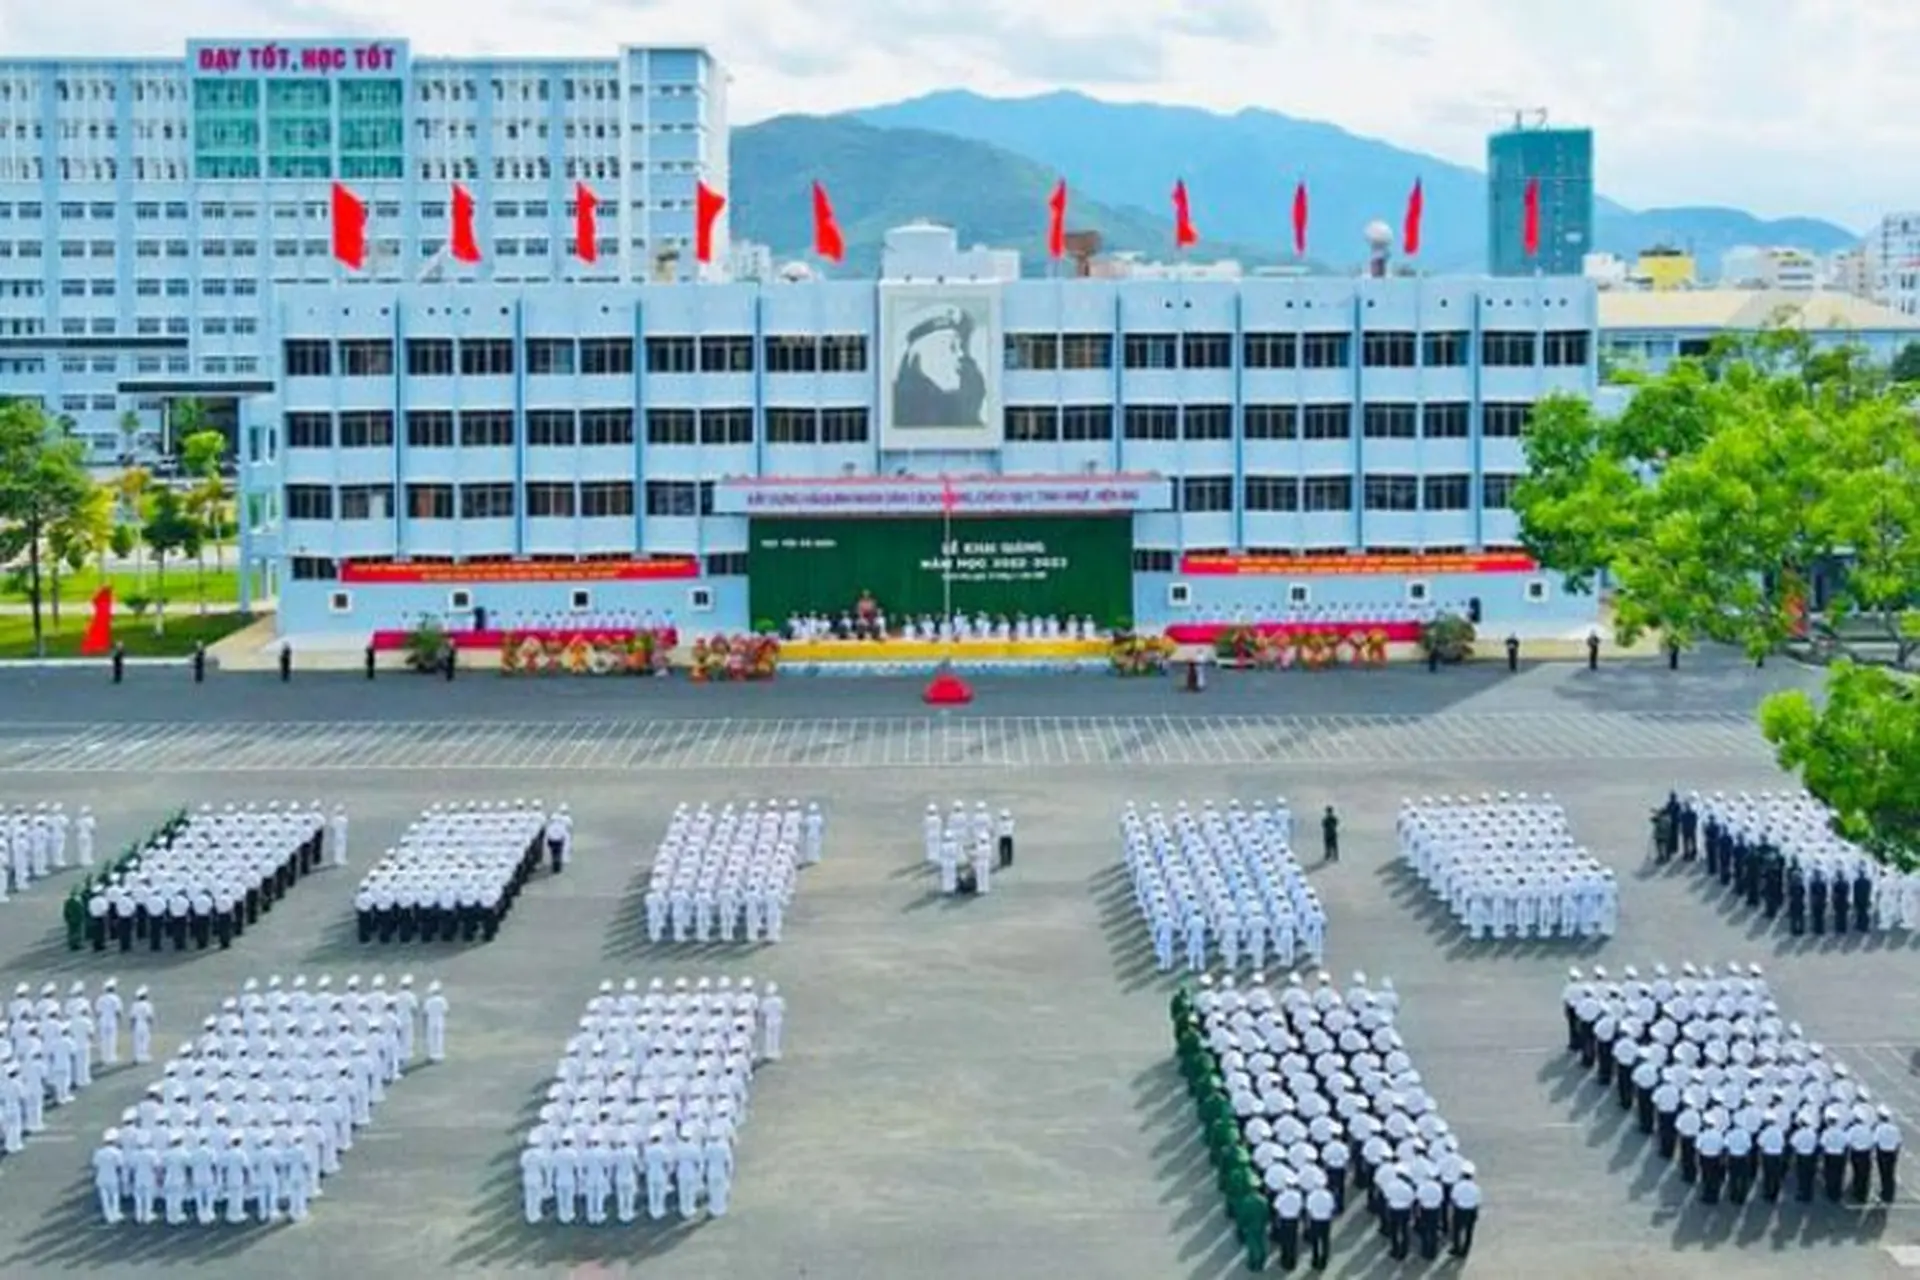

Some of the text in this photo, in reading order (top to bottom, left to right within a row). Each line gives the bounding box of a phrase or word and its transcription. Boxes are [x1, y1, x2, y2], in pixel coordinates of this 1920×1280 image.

[200, 48, 241, 74] DẠY
[301, 48, 346, 74] HỌC
[355, 42, 395, 70] TỐT
